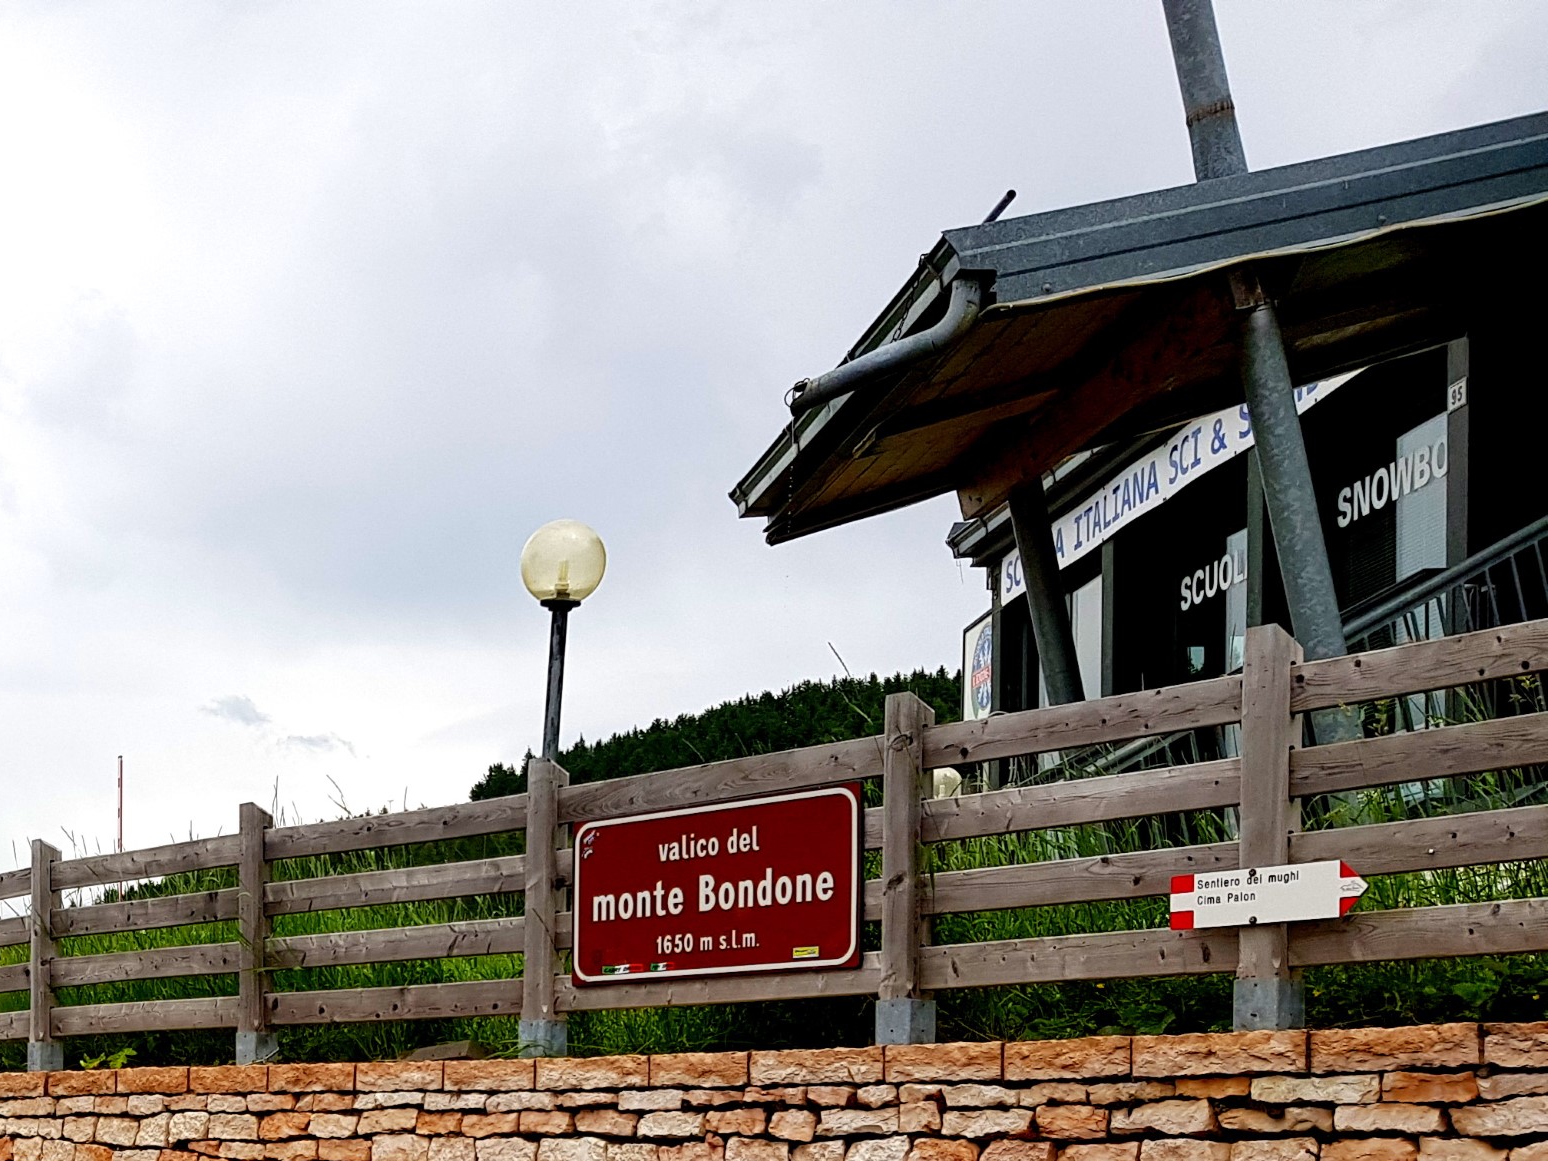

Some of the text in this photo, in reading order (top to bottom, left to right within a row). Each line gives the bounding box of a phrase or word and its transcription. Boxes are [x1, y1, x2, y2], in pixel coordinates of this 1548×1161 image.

[1451, 385, 1463, 406] 95
[1073, 461, 1160, 551] ITALIANA
[1168, 426, 1203, 486] SCI
[1210, 418, 1228, 455] &
[658, 825, 760, 862] valico del
[1197, 878, 1240, 890] Sentiero
[1268, 870, 1299, 884] mughi
[592, 867, 835, 922] monte Bondone
[1197, 892, 1256, 906] Cima Palon
[656, 929, 760, 954] 1650 m s.l.m.
